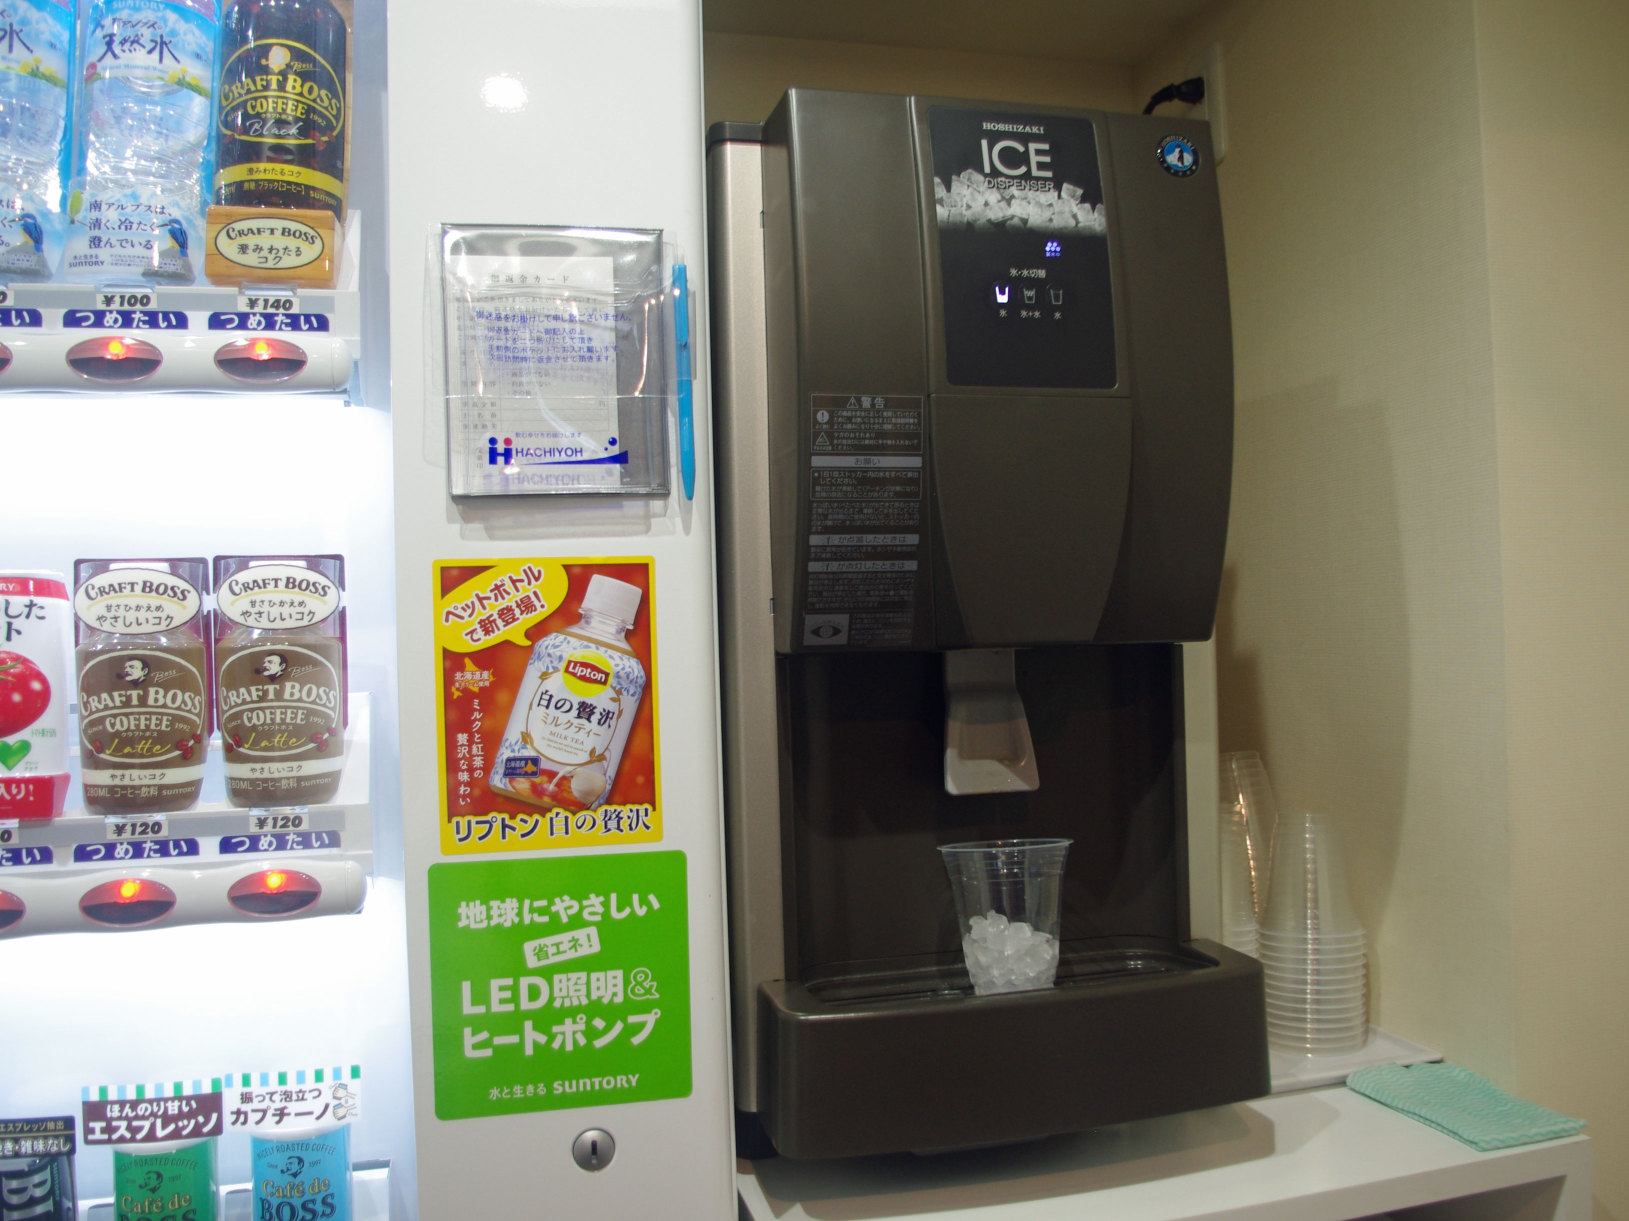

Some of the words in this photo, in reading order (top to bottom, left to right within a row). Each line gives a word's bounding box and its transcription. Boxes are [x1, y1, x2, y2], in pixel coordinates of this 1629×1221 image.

[97, 34, 181, 64] 天然水
[221, 75, 283, 106] CRAFT
[286, 75, 340, 117] BOSS
[247, 99, 307, 118] COFFEE
[246, 119, 304, 139] Black
[982, 122, 1045, 135] HOSHIZAKI
[980, 138, 1054, 178] ICE
[246, 167, 302, 178] 澄みわたるコク
[986, 177, 1055, 192] DISPENSER
[226, 227, 278, 241] CRAFT
[281, 227, 318, 246] BOSS
[237, 243, 303, 257] 澄みわたる
[258, 256, 283, 266] コク
[101, 294, 151, 309] ¥100
[246, 297, 294, 312] ¥140
[75, 311, 177, 329] つめたい
[220, 313, 318, 331] つめたい
[861, 396, 886, 409] 警告
[515, 446, 584, 458] HACHIYOH
[85, 582, 139, 601] CRAFT
[142, 580, 191, 601] BOSS
[228, 577, 282, 597] CRAFT
[285, 576, 331, 597] BOSS
[444, 564, 544, 625] ペットボトル
[105, 603, 164, 613] 甘さひかえめ
[250, 599, 306, 608] 甘さひかえめ
[96, 615, 174, 627] やさしいコク
[240, 610, 316, 622] やさしいコク
[463, 589, 547, 644] で新登場!
[568, 661, 606, 683] Lipton
[81, 690, 143, 715] CRAFT
[148, 687, 202, 713] BOSS
[220, 684, 279, 710] CRAFT
[283, 681, 337, 709] BOSS
[243, 708, 307, 727] COFFEE
[536, 689, 617, 730] 白の贅沢
[105, 714, 172, 732] COFFEE
[540, 711, 602, 738] ミルクティー
[105, 739, 171, 756] Latte
[244, 732, 306, 749] Latte
[471, 698, 485, 779] ミルクと紅茶の
[550, 730, 569, 741] MILK
[570, 736, 585, 746] TEA
[110, 772, 167, 782] やさしいコク
[250, 765, 303, 775] やさしいコク
[456, 732, 471, 806] 贅沢な味わい
[162, 785, 196, 796] SUNTORY
[301, 777, 332, 787] SUNTORY
[113, 821, 163, 838] ¥120
[255, 815, 304, 830] ¥120
[455, 815, 540, 843] リプトン
[549, 806, 652, 837] 白の贅沢
[86, 840, 188, 860] つめたい
[231, 832, 329, 852] つめたい
[457, 892, 661, 929] 地球にやさしい
[531, 931, 594, 963] 省エネ!
[461, 966, 661, 1016] LED照明&
[463, 1008, 662, 1059] ヒートポンプ
[240, 1088, 322, 1105] 振って泡立つ
[489, 1083, 547, 1101] 水と生きる
[553, 1073, 640, 1095] SUNTORY
[106, 1099, 197, 1119] ほんのり甘い
[230, 1102, 330, 1126] カプチーノ
[87, 1112, 219, 1141] エスプレッソ
[0, 1138, 71, 1156] き・雑味なし
[276, 1142, 310, 1154] ROASTED
[262, 1178, 304, 1199] Café
[308, 1176, 331, 1195] de
[168, 1192, 193, 1211] de
[258, 1192, 337, 1221] BOSS
